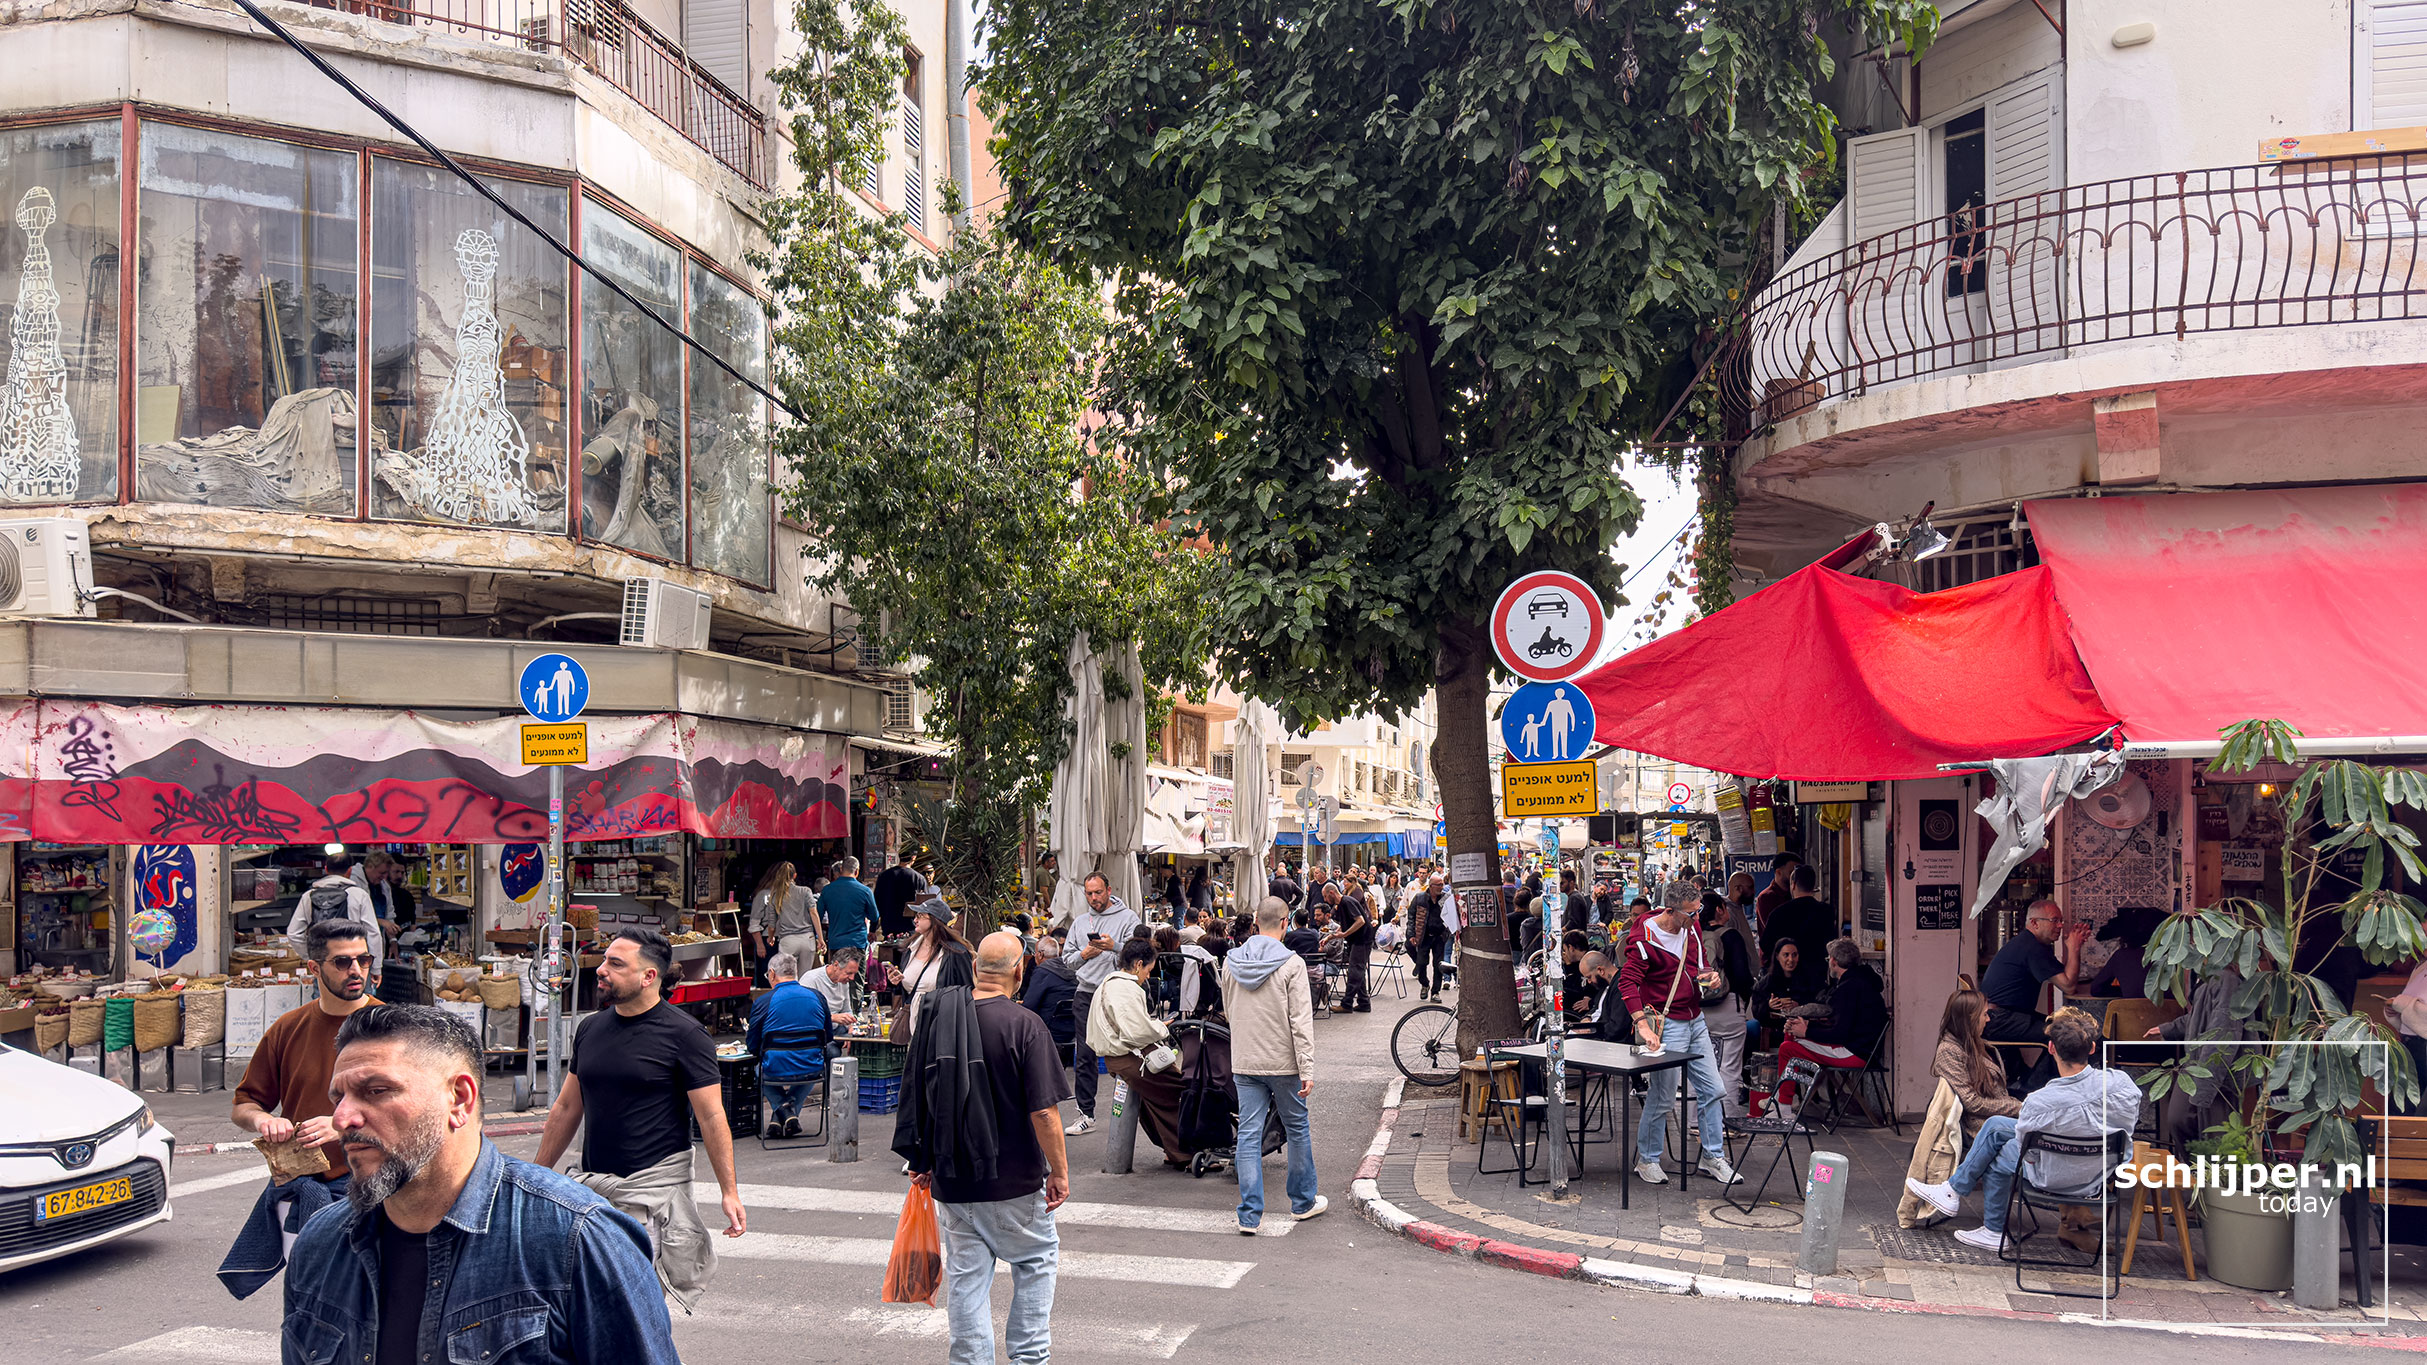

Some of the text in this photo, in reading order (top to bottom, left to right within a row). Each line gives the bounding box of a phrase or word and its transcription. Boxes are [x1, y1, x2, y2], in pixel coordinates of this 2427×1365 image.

[526, 731, 583, 741] למעט אופניים
[531, 747, 579, 757] לא ממונעים
[1509, 771, 1590, 786] למעט אופניים
[1517, 792, 1585, 807] לא ממונעים
[1944, 889, 1959, 897] PICK
[1944, 901, 1955, 910] UP
[1941, 911, 1959, 920] HERE
